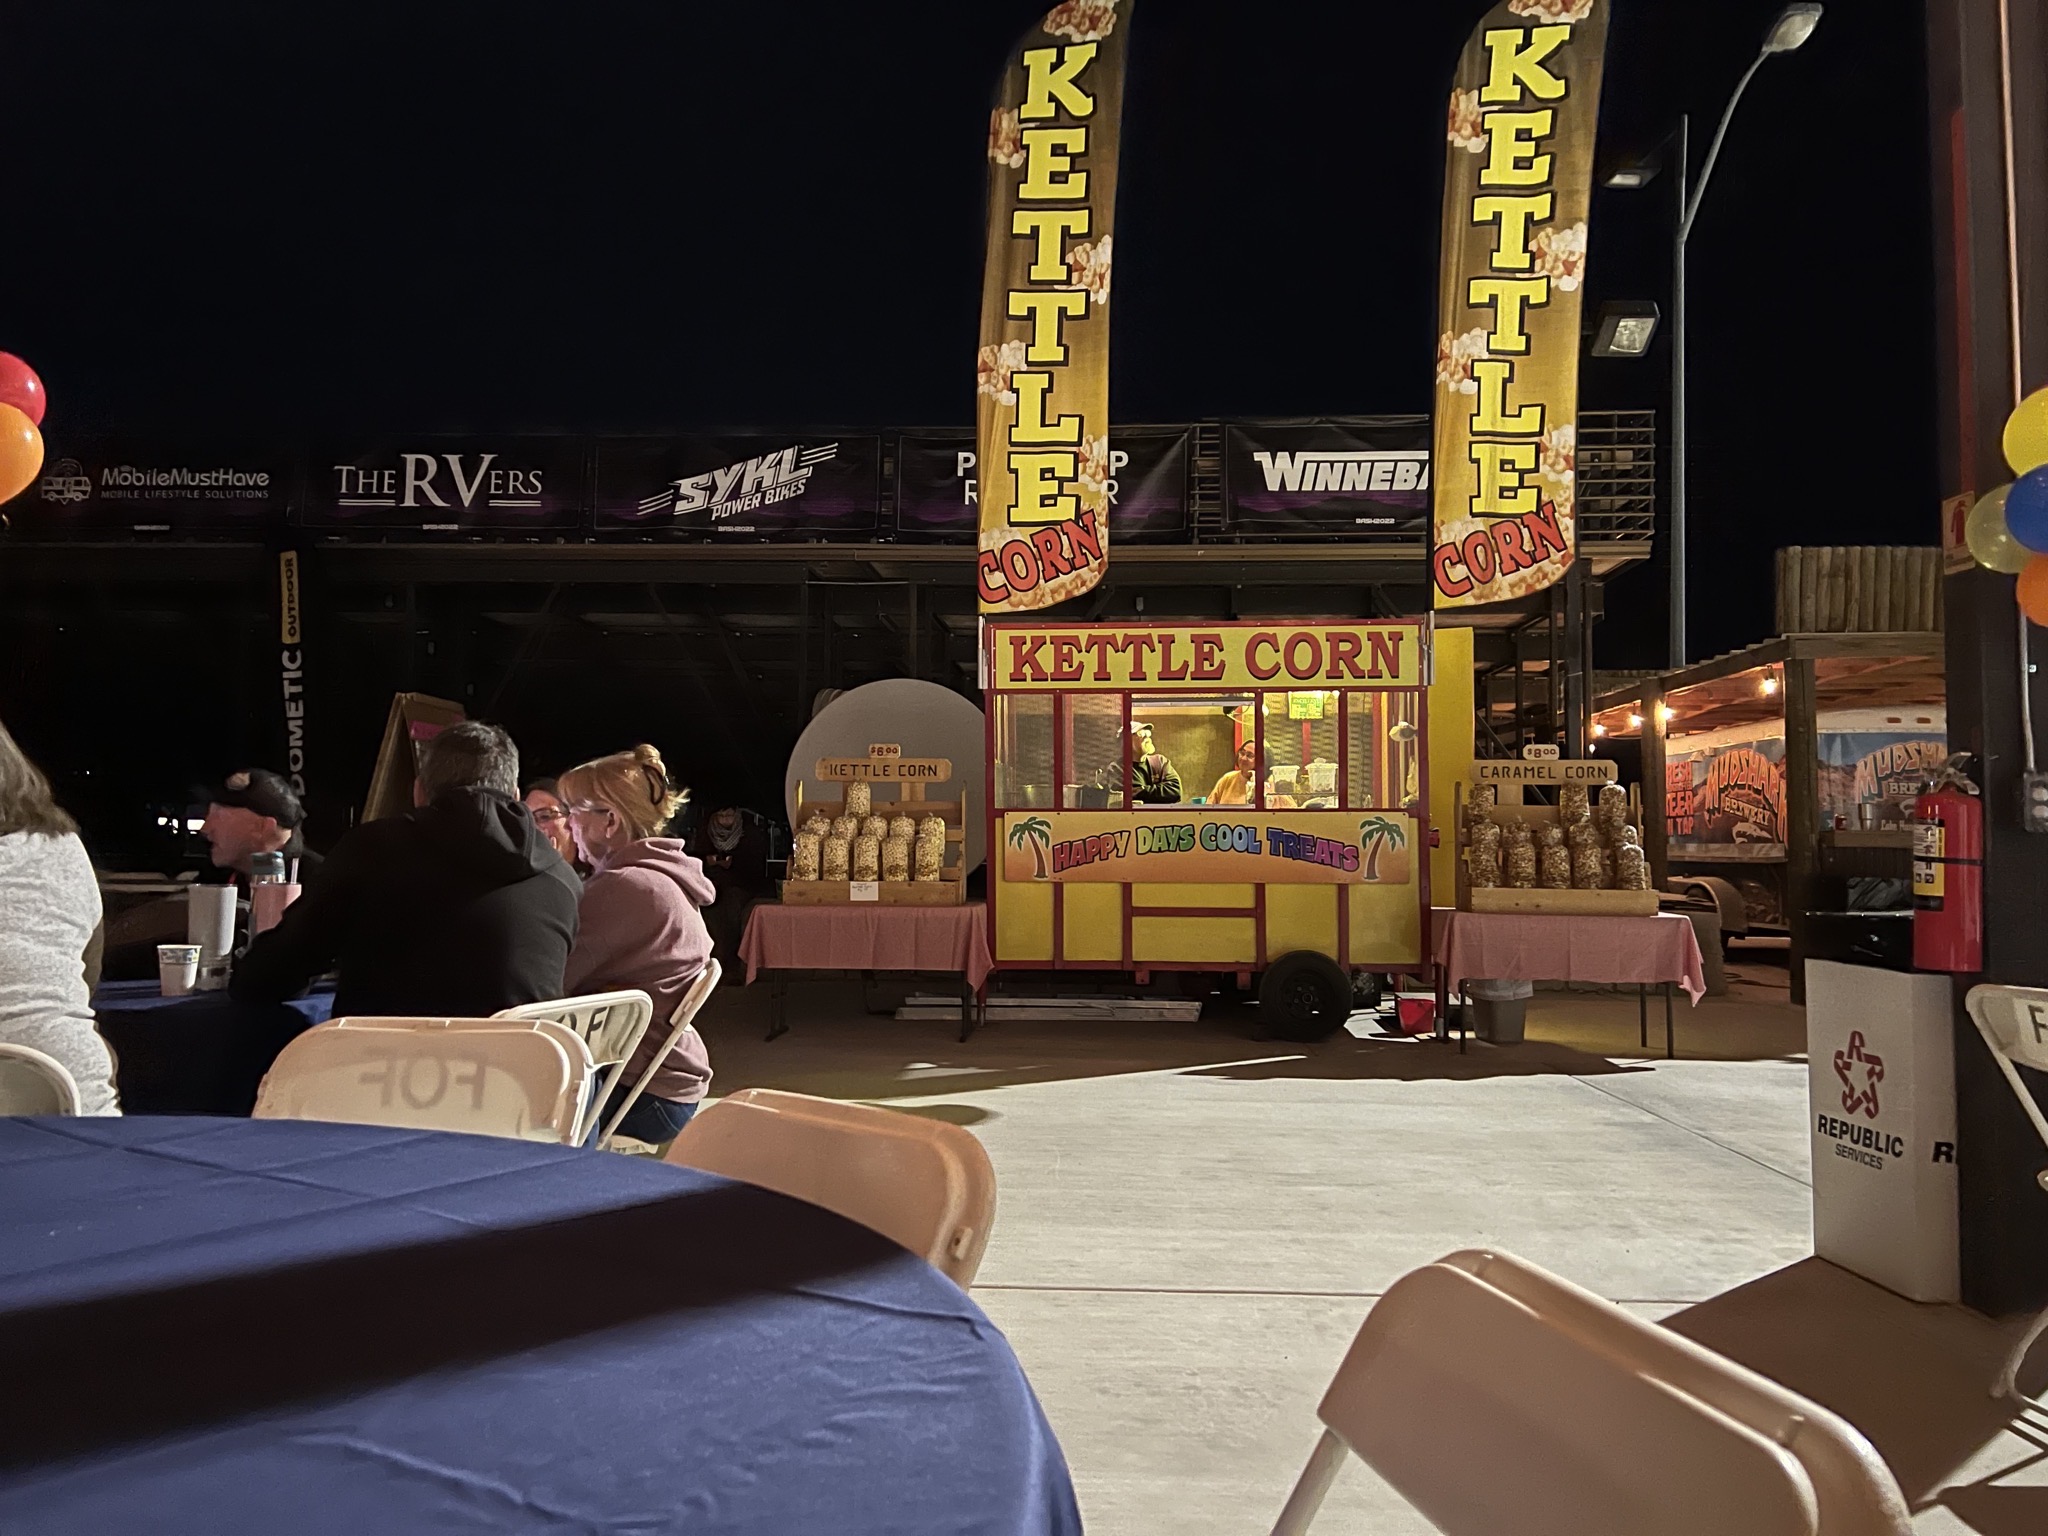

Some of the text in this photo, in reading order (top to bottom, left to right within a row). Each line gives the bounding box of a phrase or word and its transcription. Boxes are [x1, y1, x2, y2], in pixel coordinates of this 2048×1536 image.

[1007, 41, 1099, 526] KETTLE
[1468, 23, 1572, 517] KETTLE
[101, 466, 270, 486] MobileMustHave
[101, 488, 269, 499] MOBILE LIFESTYLE SOLUTIONS
[671, 445, 813, 515] SYKL
[710, 478, 807, 521] POWER BIKES
[977, 509, 1103, 604] CORN
[1434, 500, 1567, 598] CORN
[284, 557, 297, 638] OUTDOOR
[1008, 631, 1404, 682] KETTLE CORN
[282, 649, 306, 796] DOMETIC
[829, 763, 938, 777] KETTLE CORN
[1480, 765, 1609, 779] CARAMEL CORN
[1666, 762, 1693, 783] RESH
[1724, 797, 1772, 826] BREWERY
[1053, 822, 1360, 873] HAPPY DAYS COOL TREATS
[1818, 1114, 1904, 1159] REPUBLIC
[1835, 1143, 1884, 1170] SERVICES
